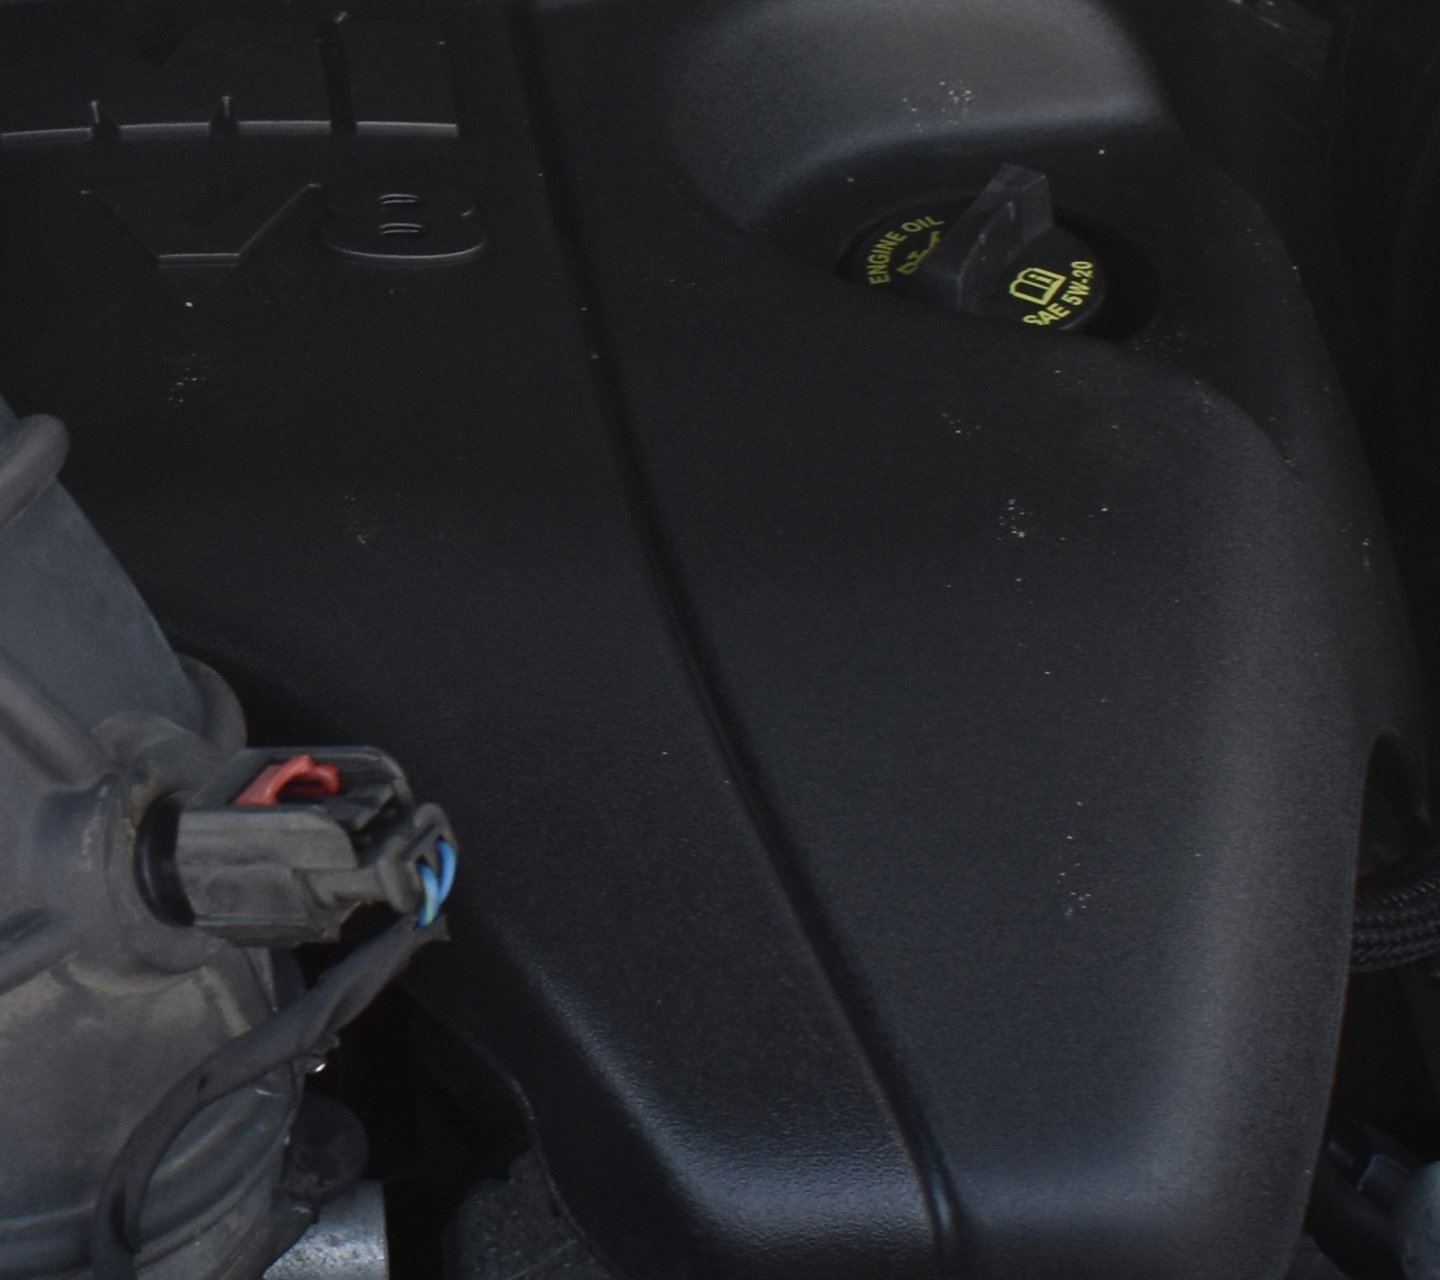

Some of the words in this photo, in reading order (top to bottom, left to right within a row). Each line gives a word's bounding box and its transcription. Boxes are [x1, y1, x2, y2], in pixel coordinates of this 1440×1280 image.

[77, 178, 490, 270] V8
[866, 228, 908, 286] ENGINE
[902, 214, 945, 237] OIL
[1021, 302, 1073, 327] SAE
[1060, 259, 1097, 307] 5W-20
